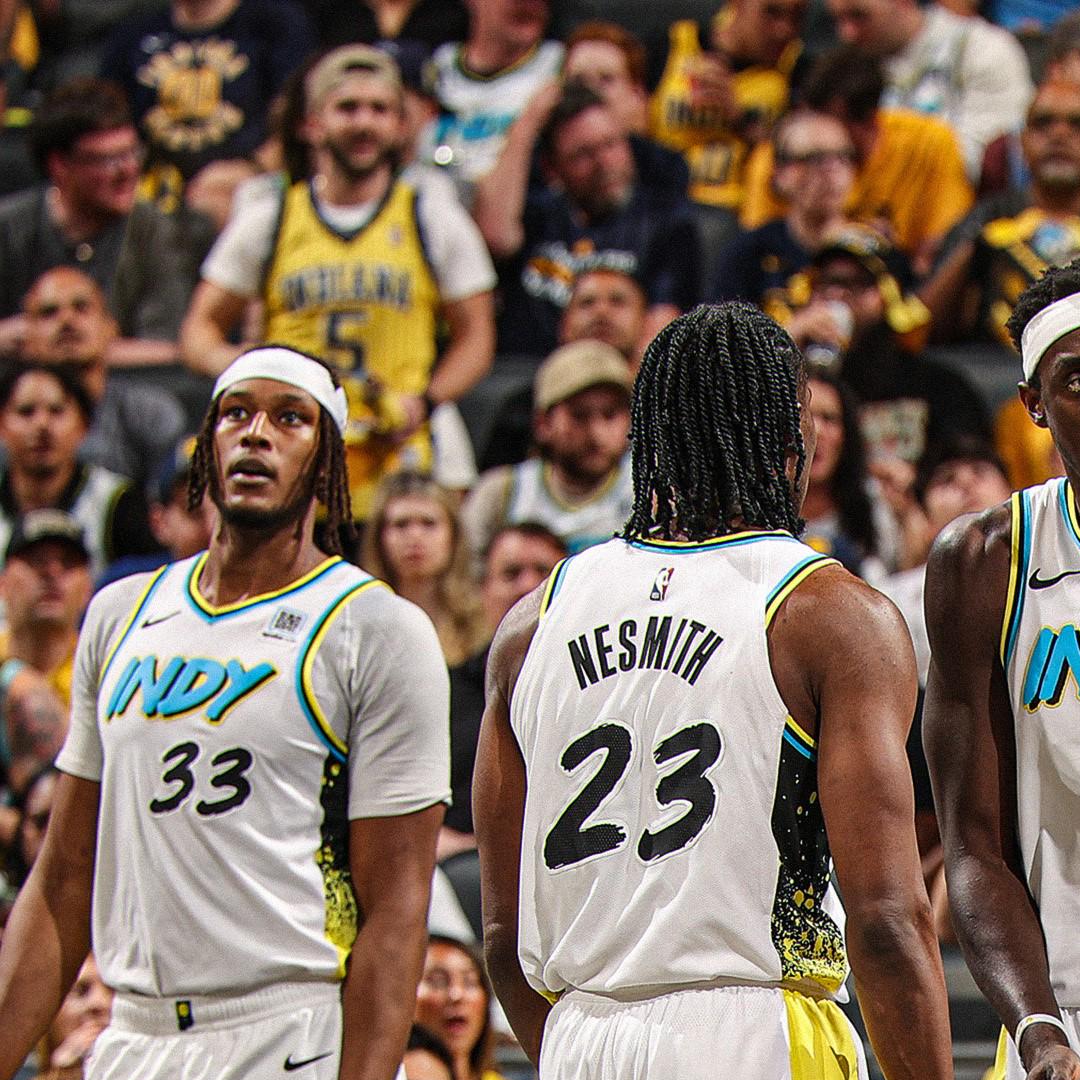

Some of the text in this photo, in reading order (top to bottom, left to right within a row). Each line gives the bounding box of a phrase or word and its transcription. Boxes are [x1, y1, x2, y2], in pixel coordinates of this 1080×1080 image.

[106, 655, 279, 726] INDY
[568, 616, 723, 690] NESMITH
[149, 740, 254, 816] 33
[544, 722, 723, 870] 23
